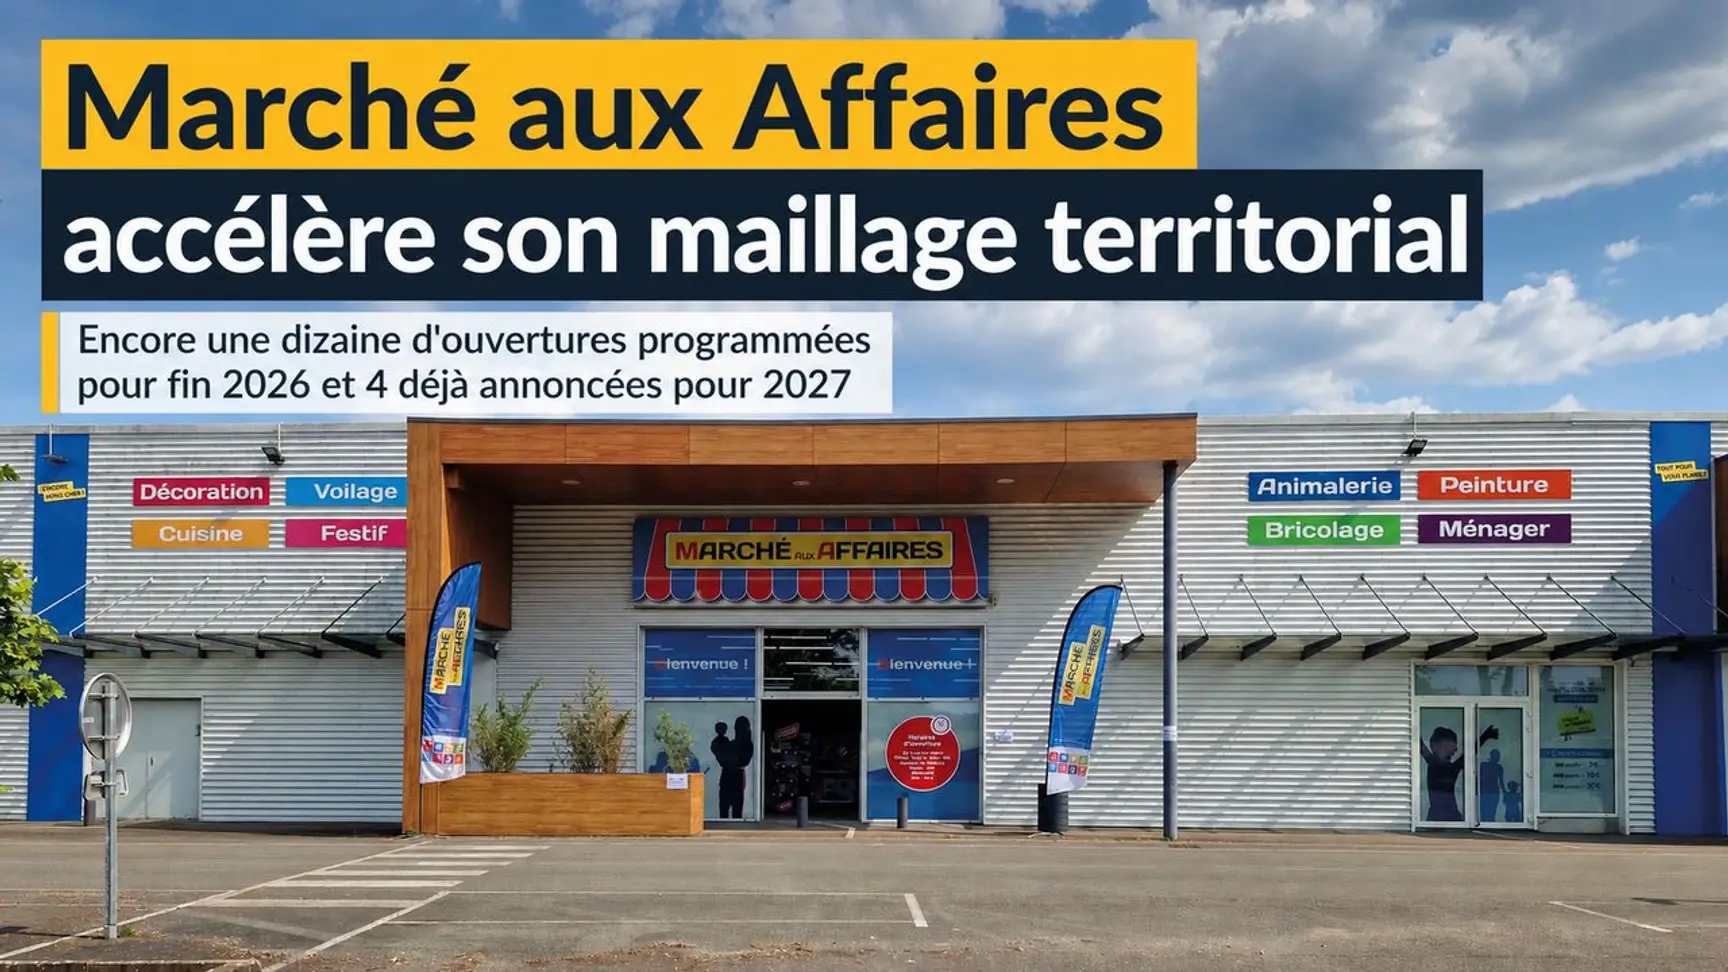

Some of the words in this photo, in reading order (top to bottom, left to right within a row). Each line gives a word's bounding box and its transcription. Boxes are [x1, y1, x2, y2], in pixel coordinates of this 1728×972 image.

[140, 483, 263, 500] Décoration
[314, 483, 398, 502] Voilage
[1257, 477, 1393, 495] Animalerie
[1440, 476, 1549, 493] Peinture
[159, 525, 243, 542] Cuisine
[321, 525, 389, 542] Festif
[1265, 521, 1384, 540] Bricolage
[1439, 518, 1551, 540] Ménager
[675, 537, 791, 561] MARCHÉ
[817, 541, 944, 560] AFFAIRES
